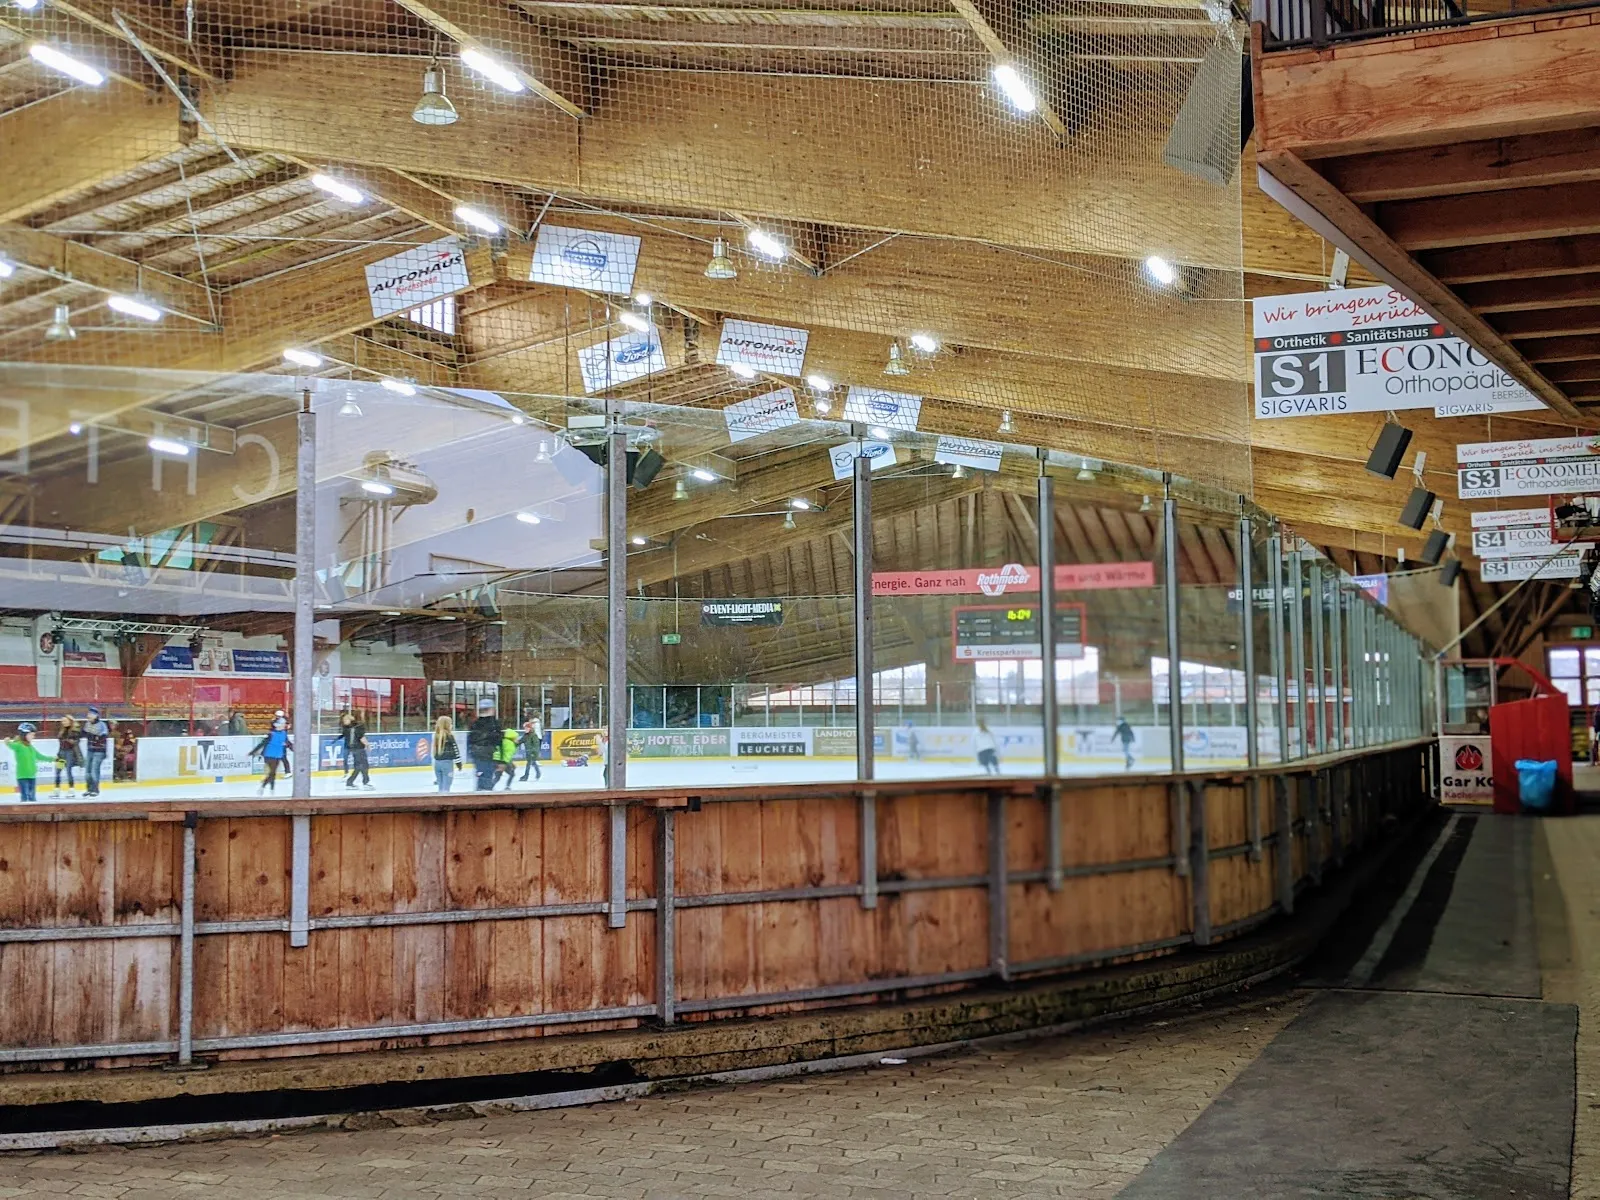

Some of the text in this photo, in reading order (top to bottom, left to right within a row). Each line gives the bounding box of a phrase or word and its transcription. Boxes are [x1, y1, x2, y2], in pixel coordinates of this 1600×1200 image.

[372, 254, 462, 294] AUTOHAUS
[1263, 291, 1408, 324] Wir bringen Si
[1352, 304, 1425, 326] zurück
[1274, 328, 1429, 349] Orthetik Sanitätshaus
[722, 337, 804, 356] AUTOHAUS
[1271, 353, 1329, 395] S1
[1261, 395, 1347, 416] SIGVARIS
[1438, 403, 1494, 416] SIGVARIS
[729, 401, 795, 427] AUTOHAUS
[940, 442, 1002, 456] AUTOHAUS
[1462, 442, 1532, 457] Wir bringen Sie
[1539, 446, 1553, 454] ins
[1465, 470, 1496, 489] S3
[1461, 489, 1502, 498] SIGVARIS
[1478, 532, 1503, 547] S4
[1484, 563, 1506, 575] S5
[914, 577, 942, 589] Ganz
[946, 576, 966, 587] nah
[976, 573, 1031, 586] Rothmoser
[647, 734, 727, 745] HOTEL EDER
[740, 731, 803, 739] BERGMEISTER
[740, 745, 803, 754] LEUCHTEN
[1443, 776, 1471, 787] Gar
